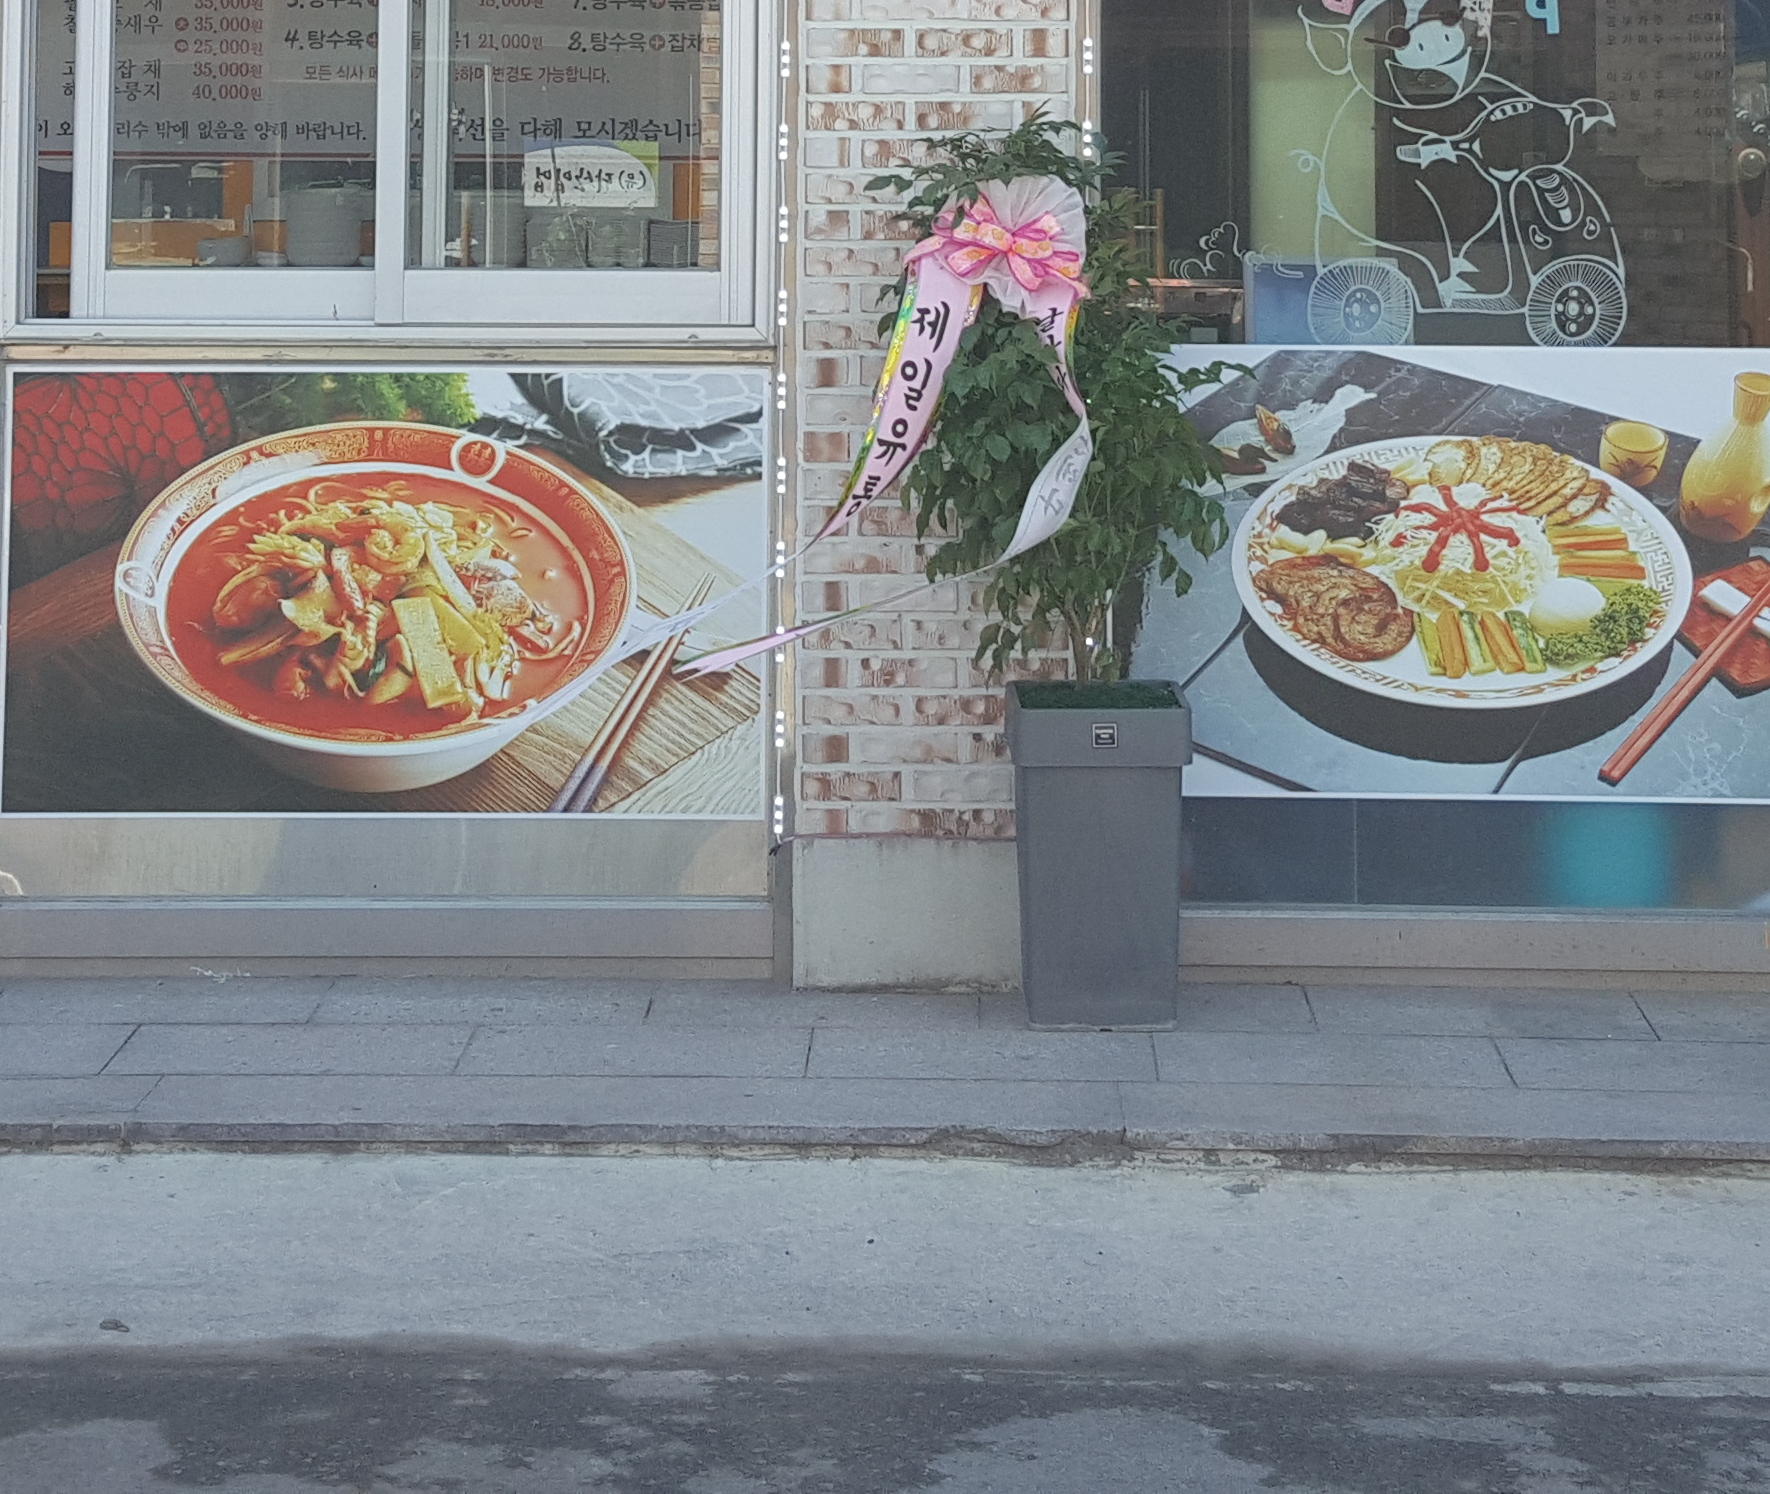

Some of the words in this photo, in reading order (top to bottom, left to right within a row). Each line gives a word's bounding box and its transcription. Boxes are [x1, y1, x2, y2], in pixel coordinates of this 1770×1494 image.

[305, 65, 332, 81] 모든
[336, 65, 362, 81] 식사
[155, 120, 188, 140] 밖에
[198, 120, 247, 140] 없음을
[255, 121, 287, 141] 양해
[296, 121, 367, 141] 바랍니다.
[519, 116, 563, 143] 다해
[846, 300, 951, 518] 제일유통
